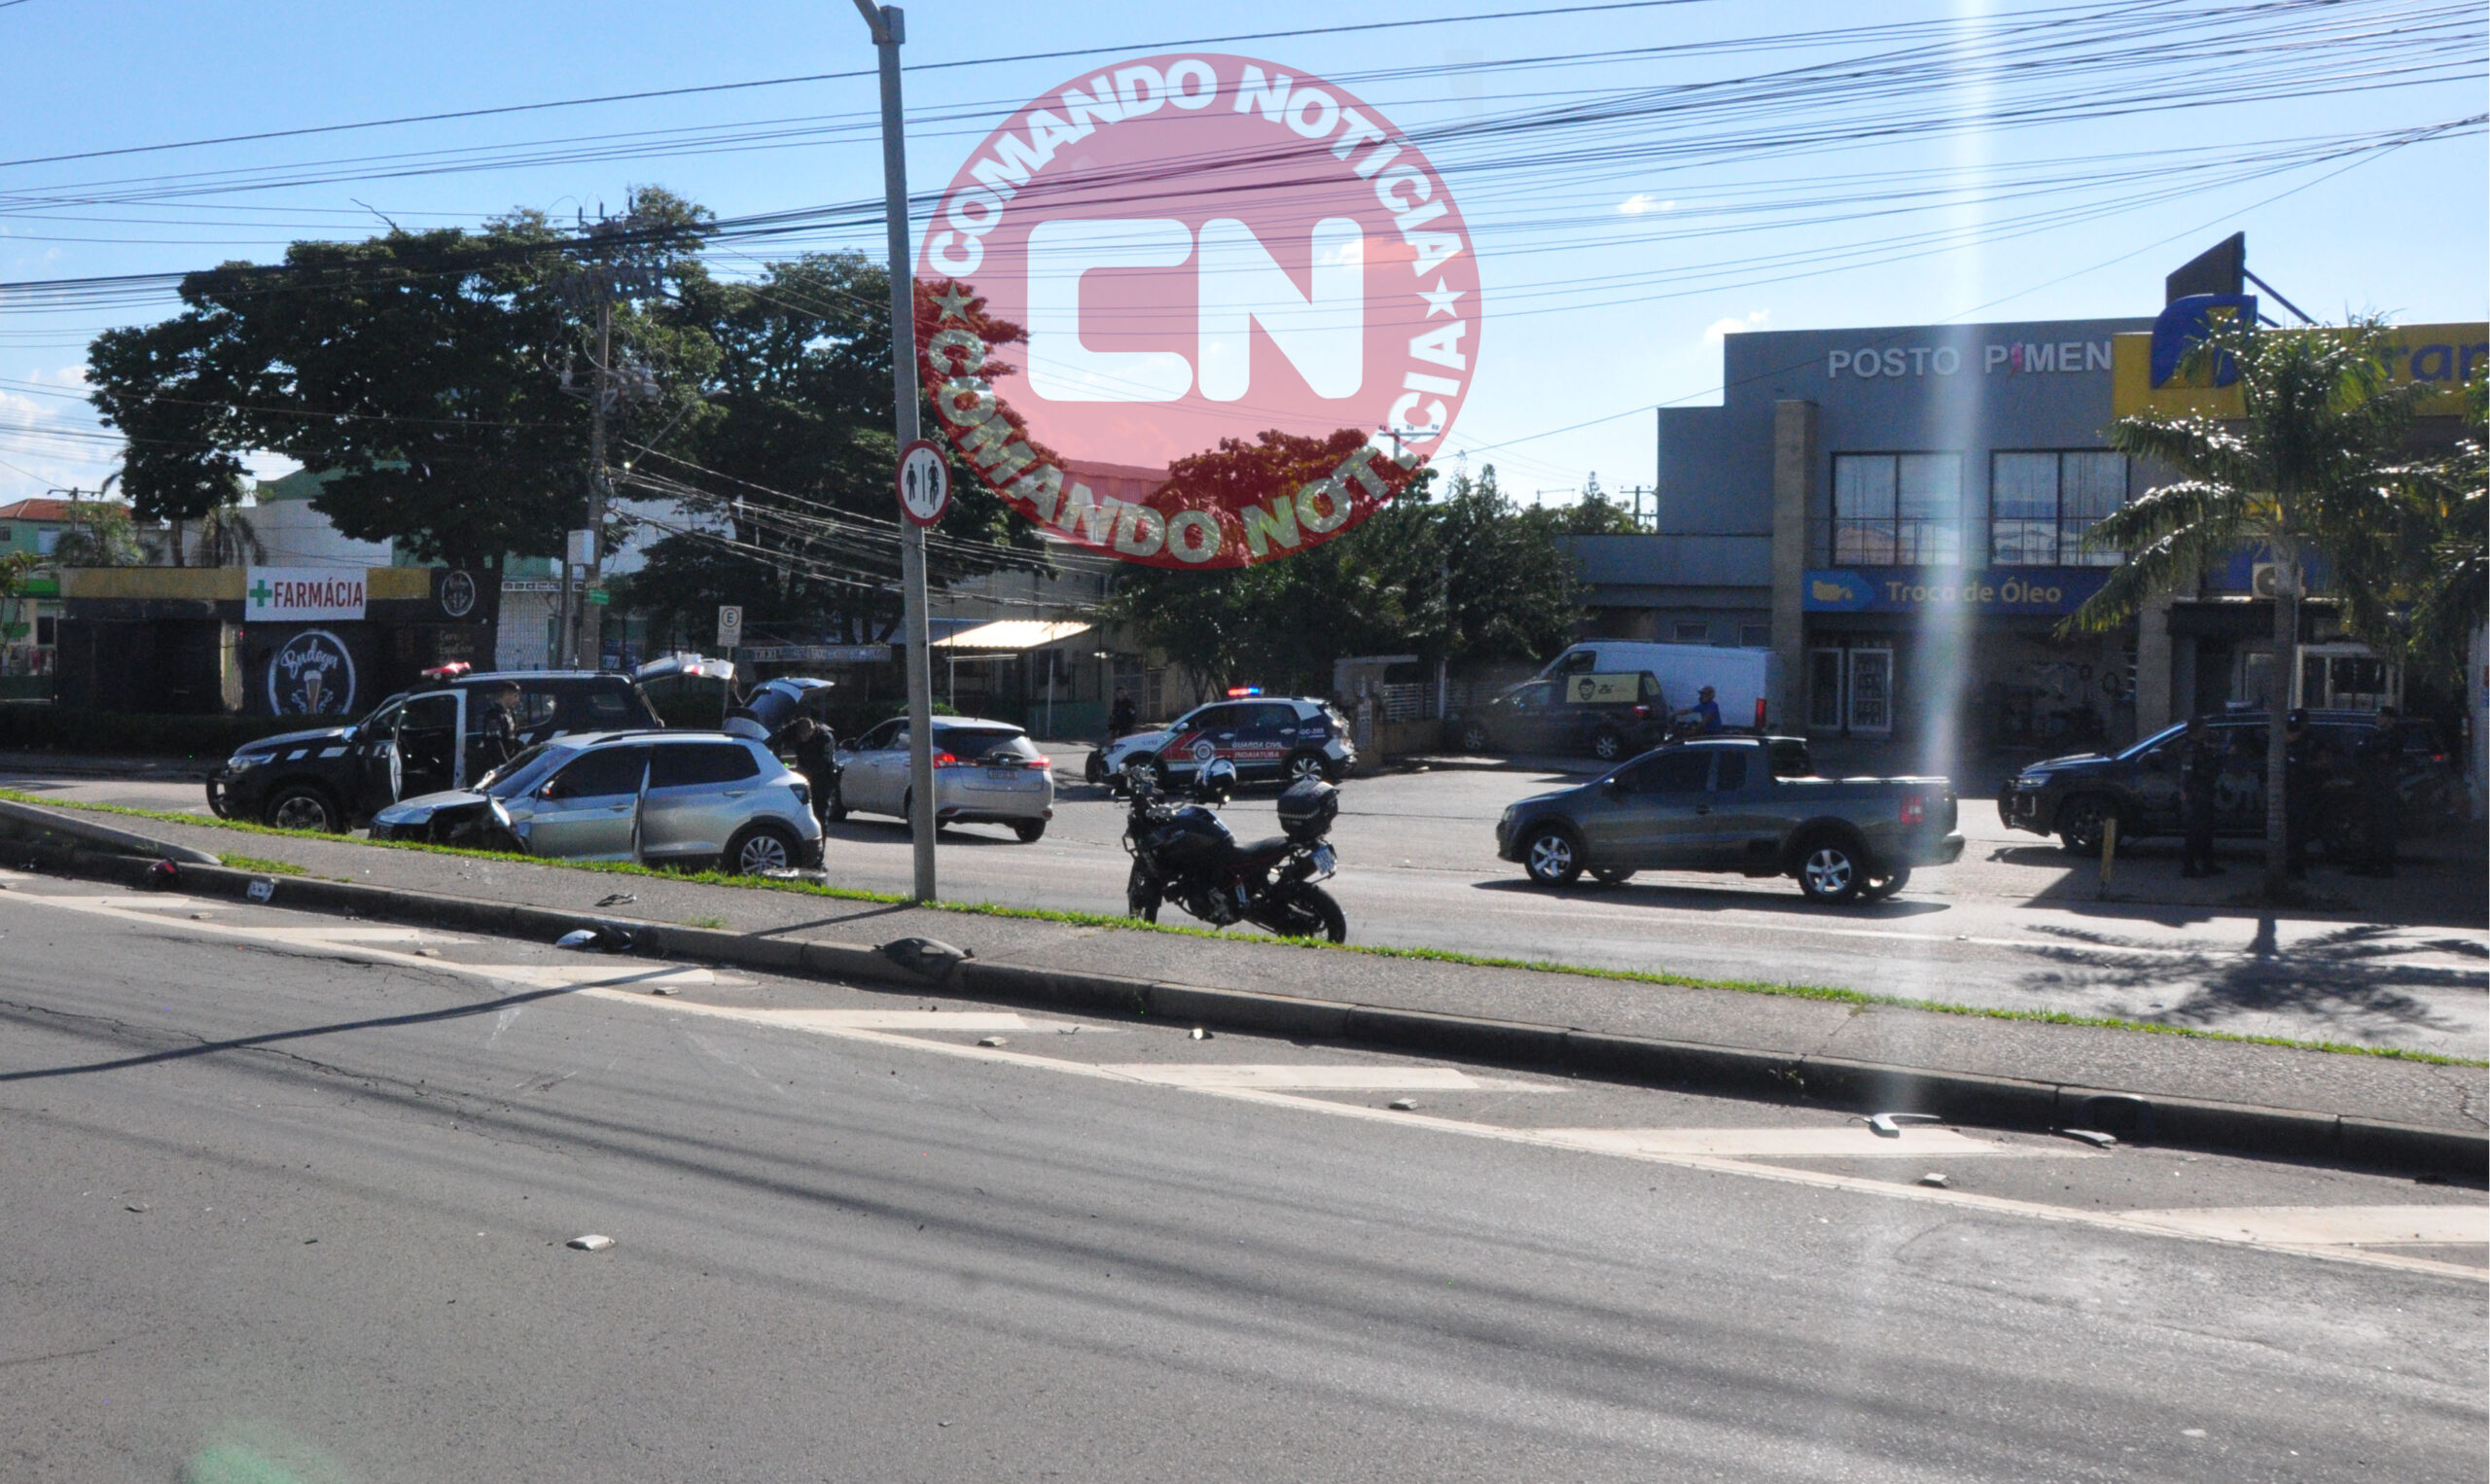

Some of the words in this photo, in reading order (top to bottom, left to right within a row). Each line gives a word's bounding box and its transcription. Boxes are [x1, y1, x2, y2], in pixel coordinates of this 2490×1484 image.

[1828, 345, 1961, 378] POSTO
[273, 577, 364, 608] FARMÁCIA
[1885, 582, 1956, 602] Troca
[1965, 581, 1995, 602] de
[2001, 576, 2062, 603] Óleo
[727, 612, 734, 623] E
